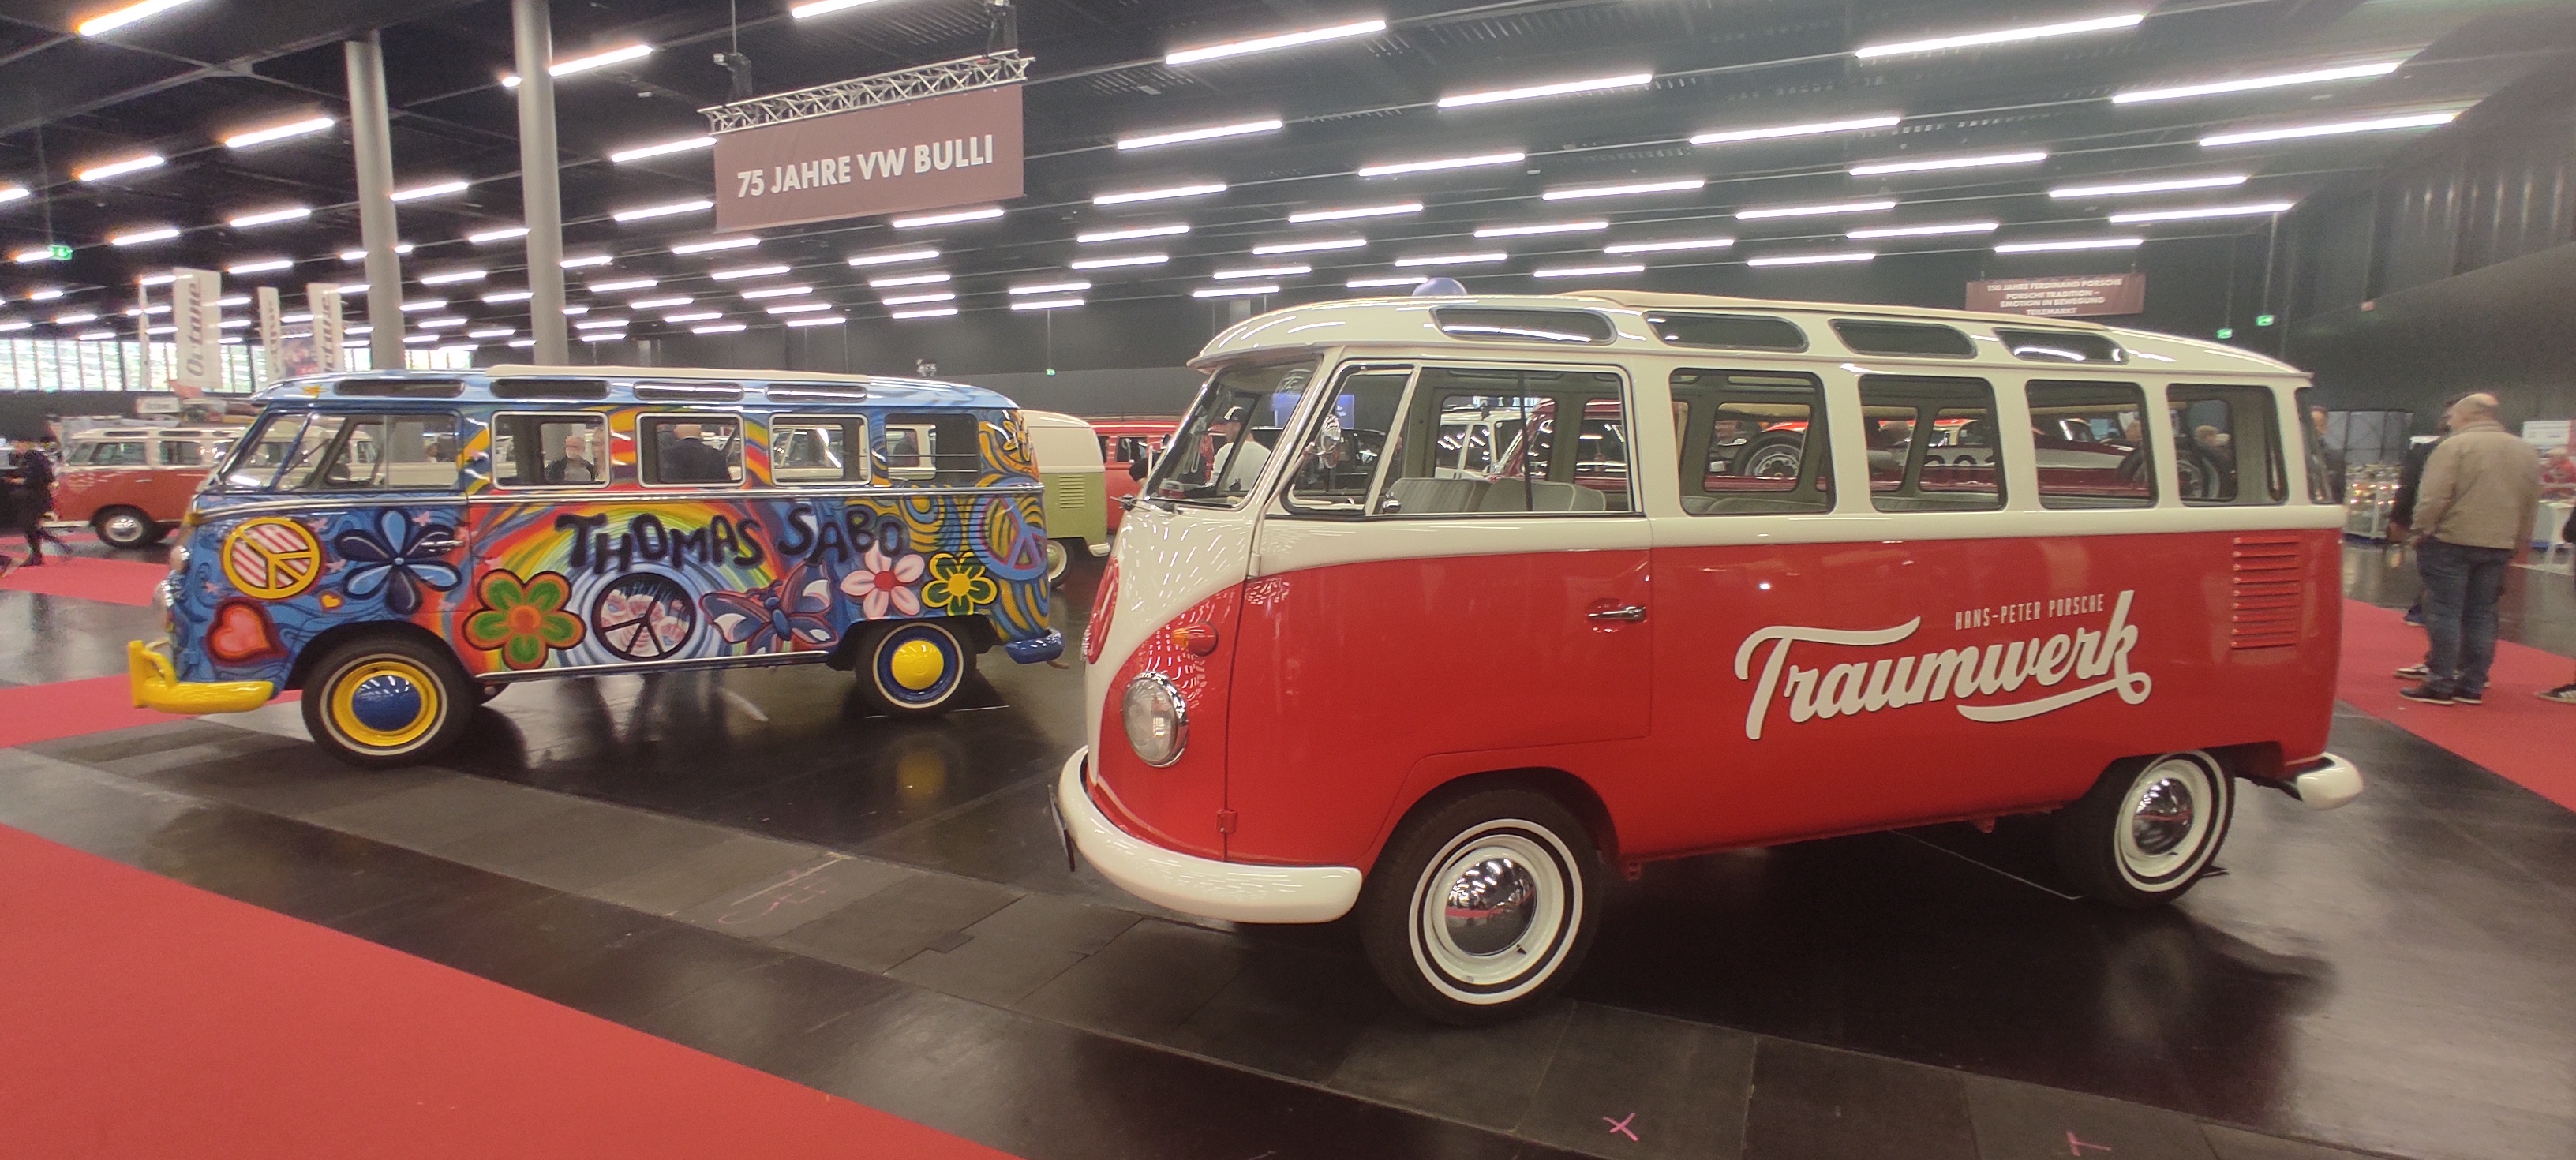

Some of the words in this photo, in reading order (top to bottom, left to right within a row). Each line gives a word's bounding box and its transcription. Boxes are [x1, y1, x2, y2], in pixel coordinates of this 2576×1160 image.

[737, 169, 765, 198] 75
[771, 155, 852, 194] JAHRE
[857, 147, 907, 181] VW
[914, 133, 994, 174] BULLI
[2046, 290, 2093, 298] TRADITION
[2081, 278, 2123, 287] PORSCHE
[2026, 307, 2077, 316] TEILEMARKT
[2054, 297, 2106, 306] BEWEGUNG
[554, 512, 766, 574] THOMAS
[778, 503, 907, 565] SABO
[1955, 601, 2041, 631] HANS-PETER
[2049, 593, 2104, 618] PORSCHE
[1735, 589, 2153, 740] Traumwerk
